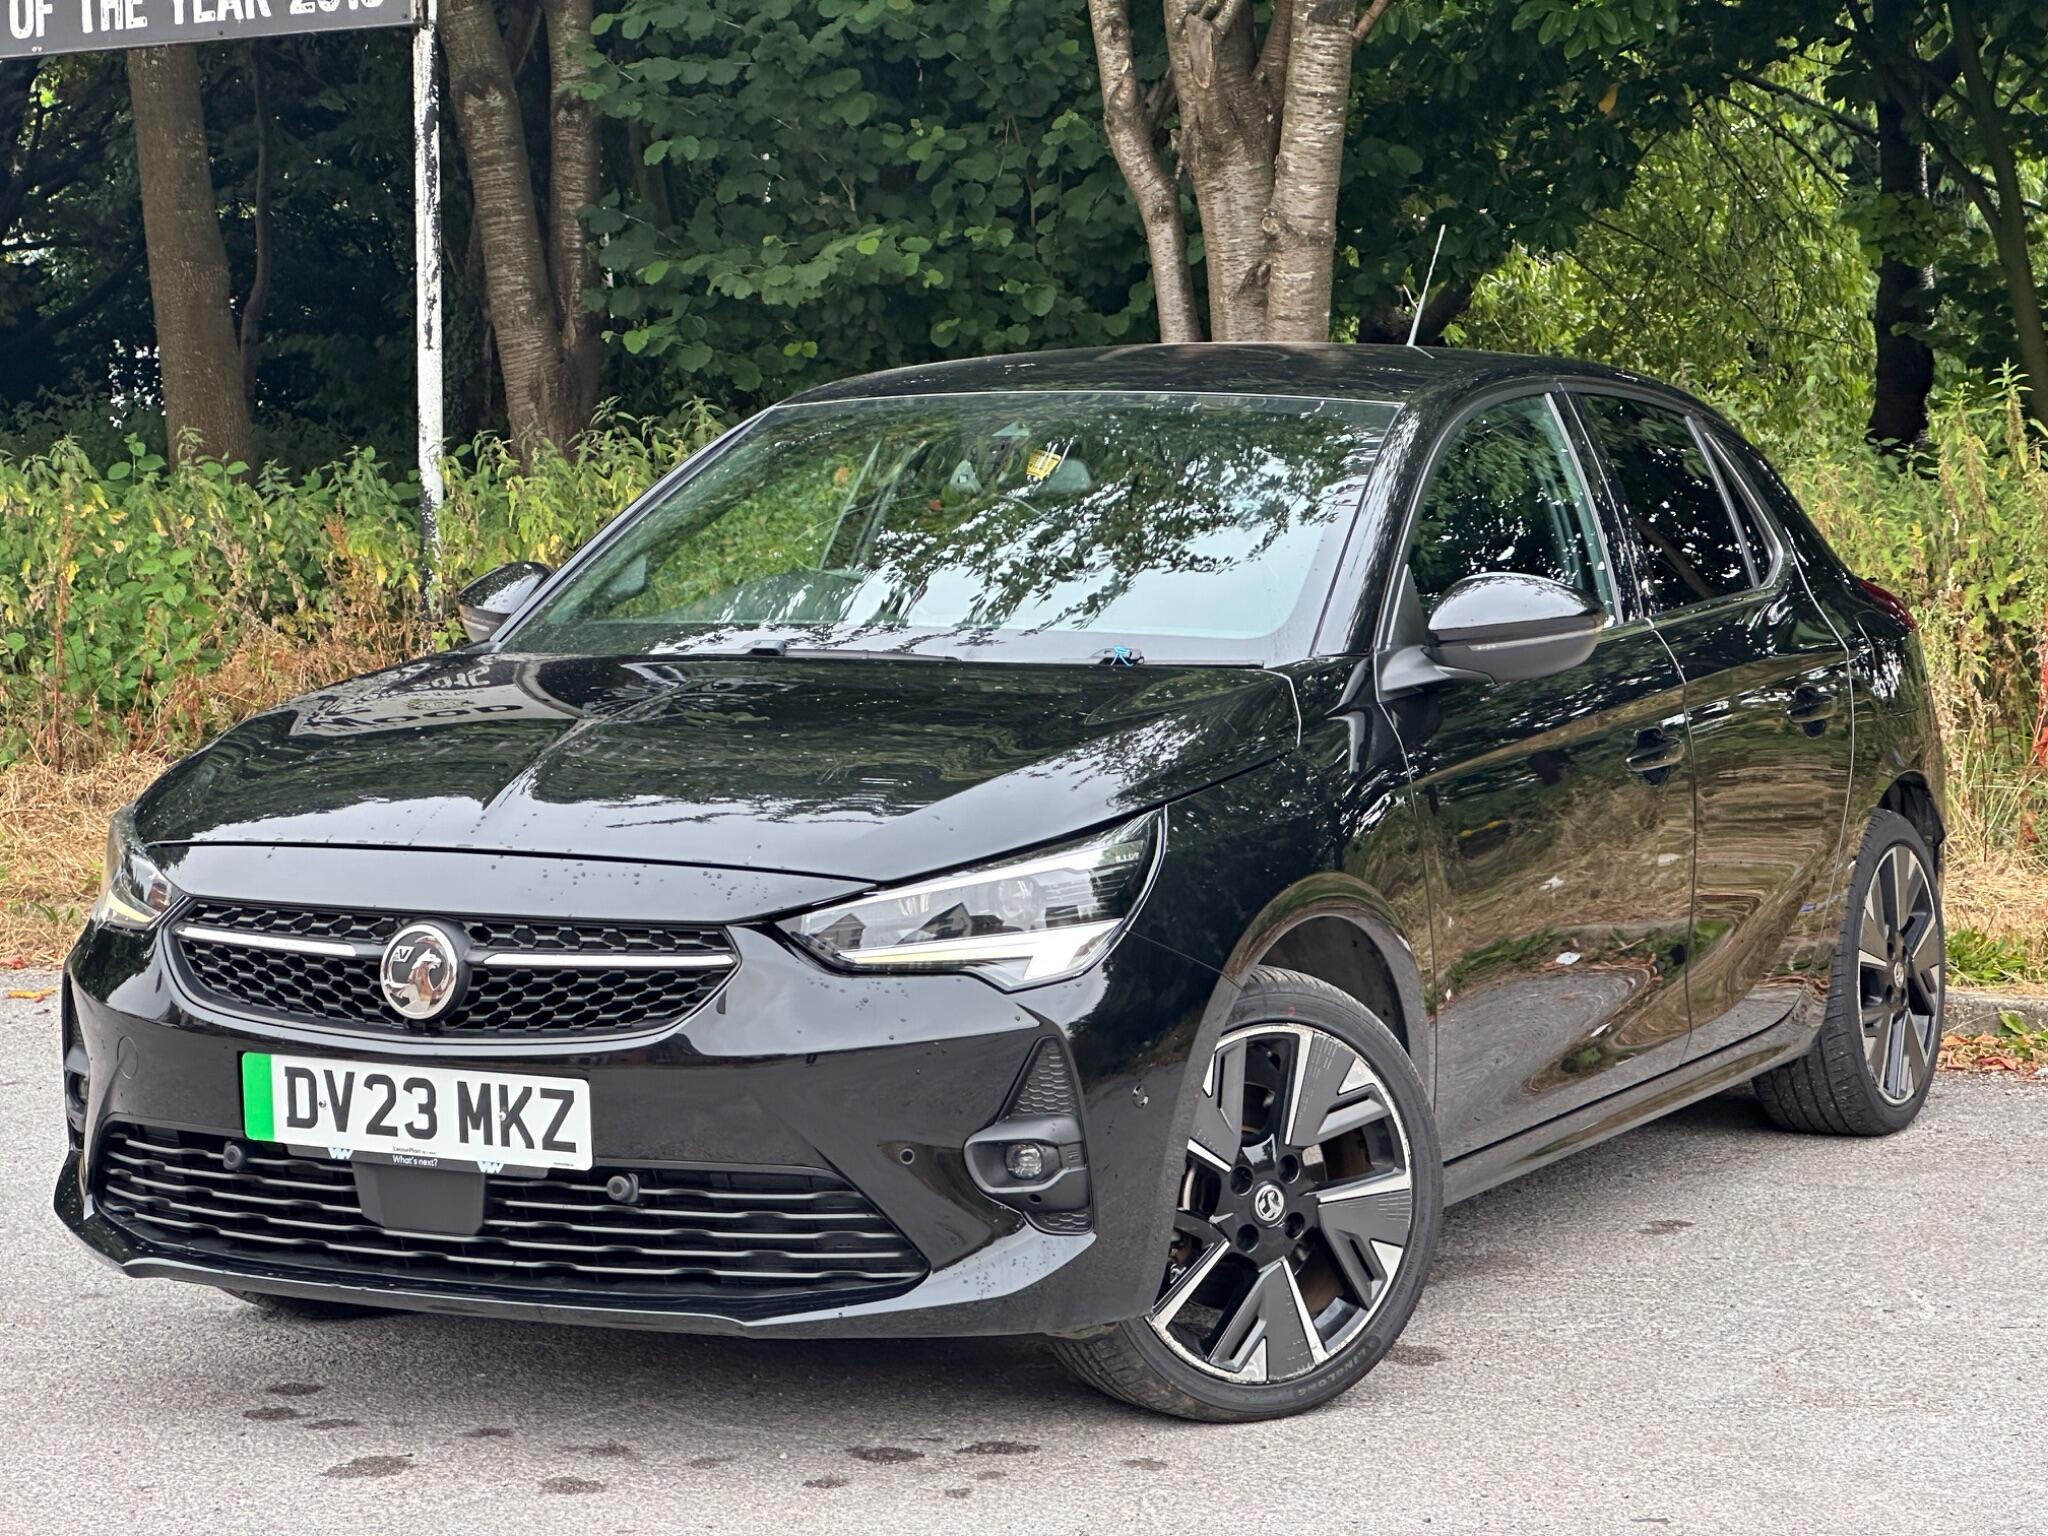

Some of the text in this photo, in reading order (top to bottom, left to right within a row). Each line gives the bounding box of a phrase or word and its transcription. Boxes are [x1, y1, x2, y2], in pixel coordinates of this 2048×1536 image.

[9, 0, 53, 39] OF
[81, 0, 148, 34] THE
[284, 1066, 577, 1153] DV23 MKZ
[392, 1155, 438, 1167] What's next?
